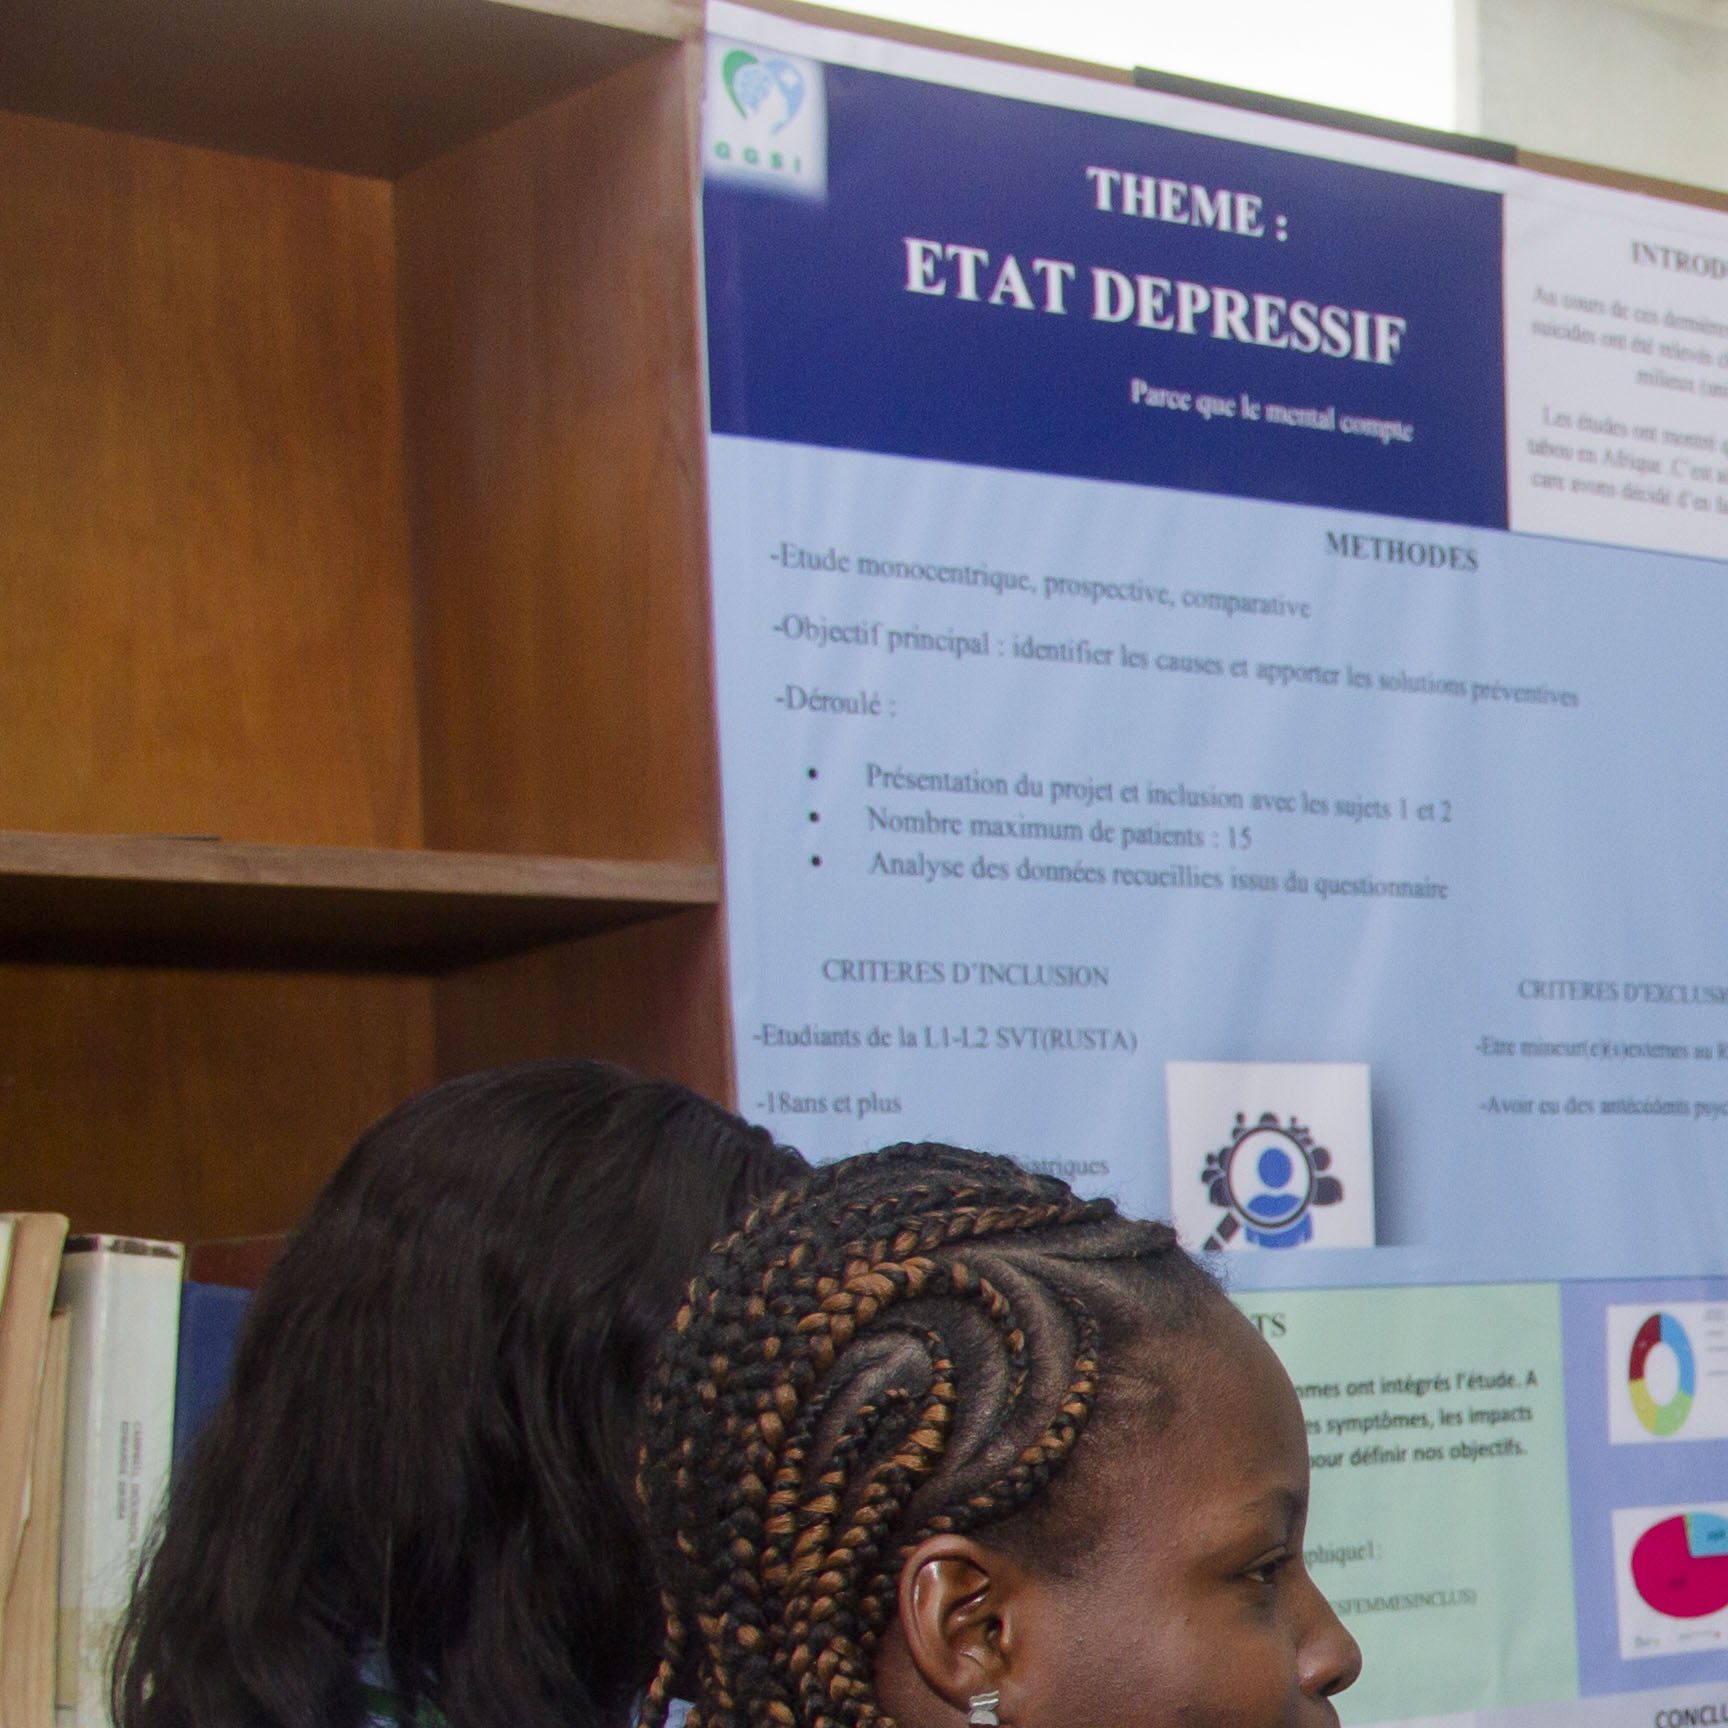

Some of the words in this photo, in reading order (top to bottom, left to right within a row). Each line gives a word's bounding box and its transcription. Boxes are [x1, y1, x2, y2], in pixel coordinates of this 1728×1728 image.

[1087, 166, 1263, 238] THEME
[1276, 213, 1289, 242] :
[904, 237, 1074, 316] ETAT
[1091, 269, 1406, 365] DEPRESSIF
[1130, 378, 1189, 411] Parce
[1196, 390, 1236, 421] que
[1240, 392, 1259, 420] le
[1265, 397, 1335, 432] mental
[1341, 411, 1414, 445] compte
[1326, 530, 1479, 572] METHODES
[857, 558, 1037, 595] monocentrique,
[1044, 573, 1176, 609] prospective,
[1181, 583, 1311, 619] comparative
[888, 624, 989, 659] principal
[1013, 640, 1112, 667] identifier
[1120, 644, 1149, 670] les
[1155, 652, 1224, 677] causes
[1230, 657, 1248, 677] et
[1256, 662, 1339, 687] apporter
[1346, 665, 1373, 691] les
[1380, 670, 1468, 698] solutions
[1471, 679, 1580, 708] préventives
[866, 763, 1008, 796] Présentation
[1015, 771, 1044, 799] du
[1050, 777, 1114, 805] projet
[1120, 784, 1139, 805] et
[1146, 780, 1243, 810] inclusion
[1251, 791, 1296, 814] avec
[1302, 791, 1329, 816] les
[1335, 794, 1391, 823] sujets
[1399, 798, 1408, 821] 1
[1417, 800, 1438, 821] et
[1439, 800, 1452, 823] 2
[867, 806, 963, 835] Nombre
[970, 817, 1083, 841] maximum
[1089, 818, 1115, 845] de
[1121, 822, 1204, 850] patients
[1227, 824, 1252, 850] 15
[869, 850, 964, 883] Analyse
[972, 855, 1010, 880] des
[1016, 855, 1106, 884] données
[1112, 863, 1223, 890] recueillies
[1231, 870, 1279, 893] issus
[1284, 870, 1309, 895] du
[1314, 872, 1448, 900] questionnaire
[822, 959, 945, 984] CRITERES
[952, 962, 1109, 987] D'INCLUSION
[1518, 979, 1619, 1002] CRITERES
[868, 1025, 892, 1048] de
[899, 1024, 918, 1048] la
[924, 1025, 989, 1049] L1-L2
[833, 1092, 852, 1115] et
[856, 1092, 902, 1120] plus
[1347, 1381, 1375, 1396] ont
[1380, 1376, 1451, 1396] intégrés
[1456, 1370, 1521, 1390] l'étude.
[1525, 1371, 1538, 1387] A
[1327, 1410, 1434, 1439] symptômes,
[1439, 1408, 1463, 1427] les
[1469, 1405, 1533, 1426] impacts
[1350, 1447, 1406, 1467] définir
[1414, 1446, 1444, 1464] nos
[1450, 1437, 1528, 1462] objectifs.
